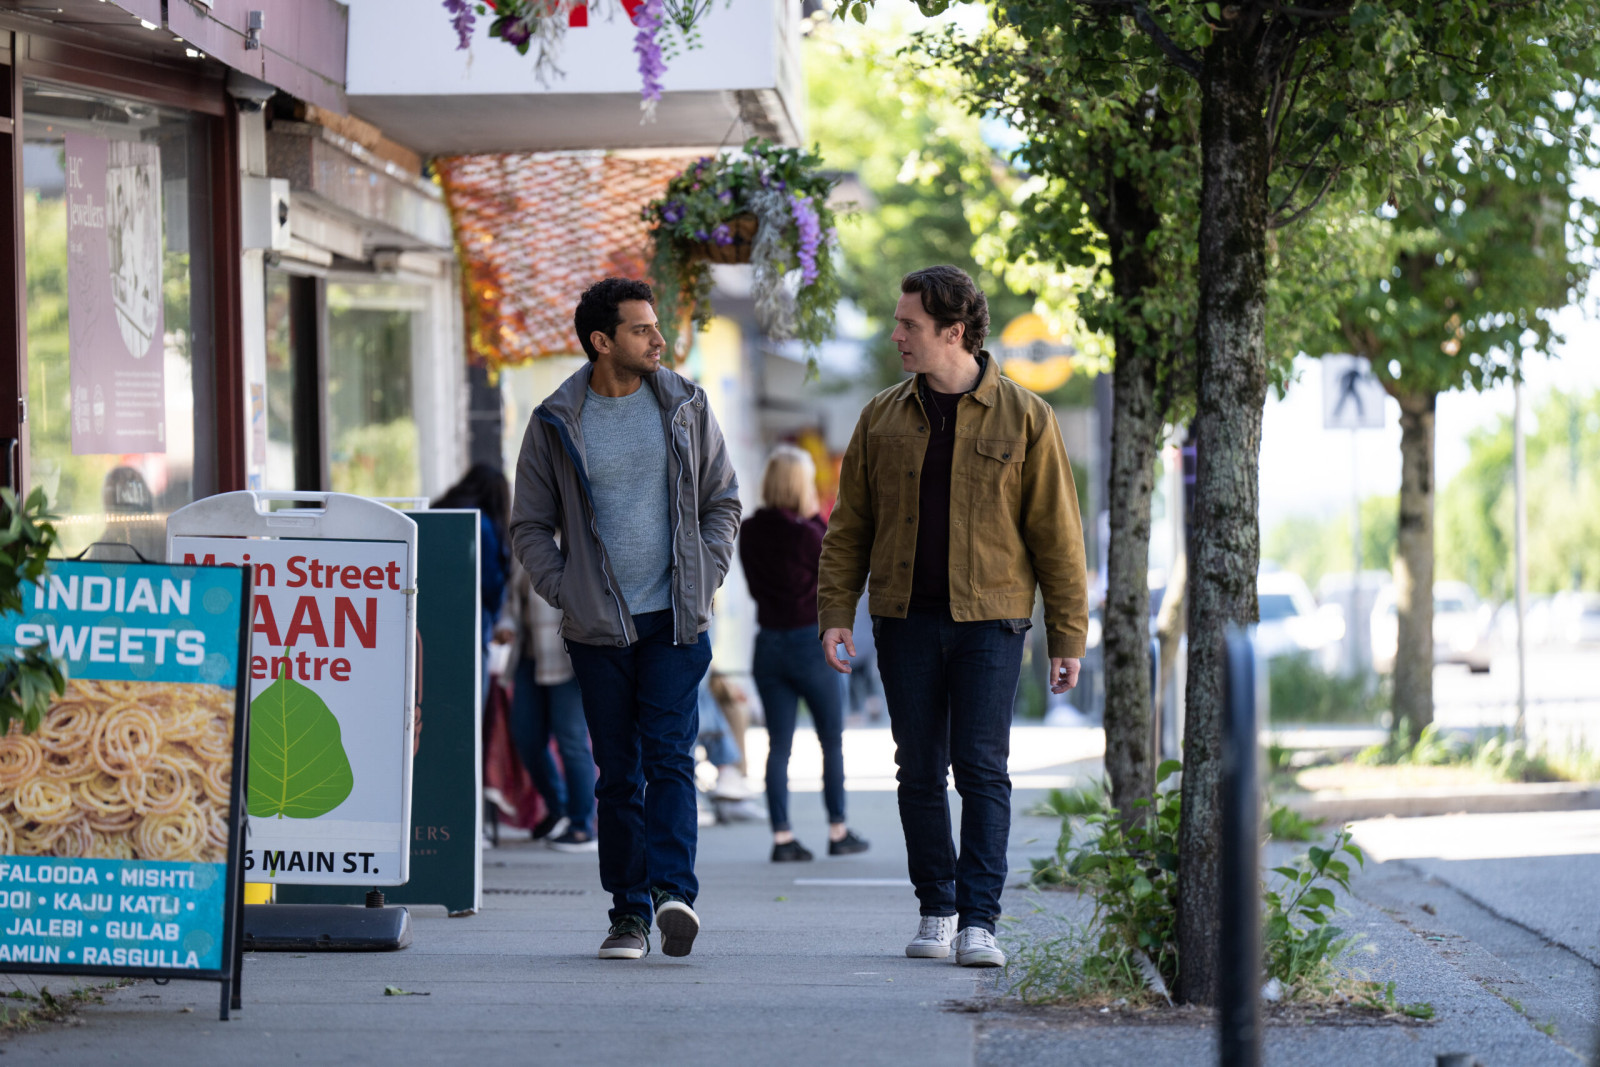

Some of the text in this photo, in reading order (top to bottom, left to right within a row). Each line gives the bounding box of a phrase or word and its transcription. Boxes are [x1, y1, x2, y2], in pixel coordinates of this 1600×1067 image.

[69, 155, 83, 189] HC
[69, 193, 104, 232] Jewellers
[286, 556, 401, 591] Street
[34, 574, 191, 615] INDIAN
[253, 594, 378, 649] AAN
[14, 623, 206, 666] SWEETS
[251, 651, 352, 682] entre
[415, 825, 450, 841] ERS
[0, 864, 195, 889] FALOODA MISHTI
[245, 849, 379, 874] 6 MAIN ST.
[54, 892, 113, 912] KAJU
[120, 895, 180, 915] KATLI
[6, 918, 180, 941] JALEBI GULAB
[0, 944, 200, 969] AMUN RASGULLA
